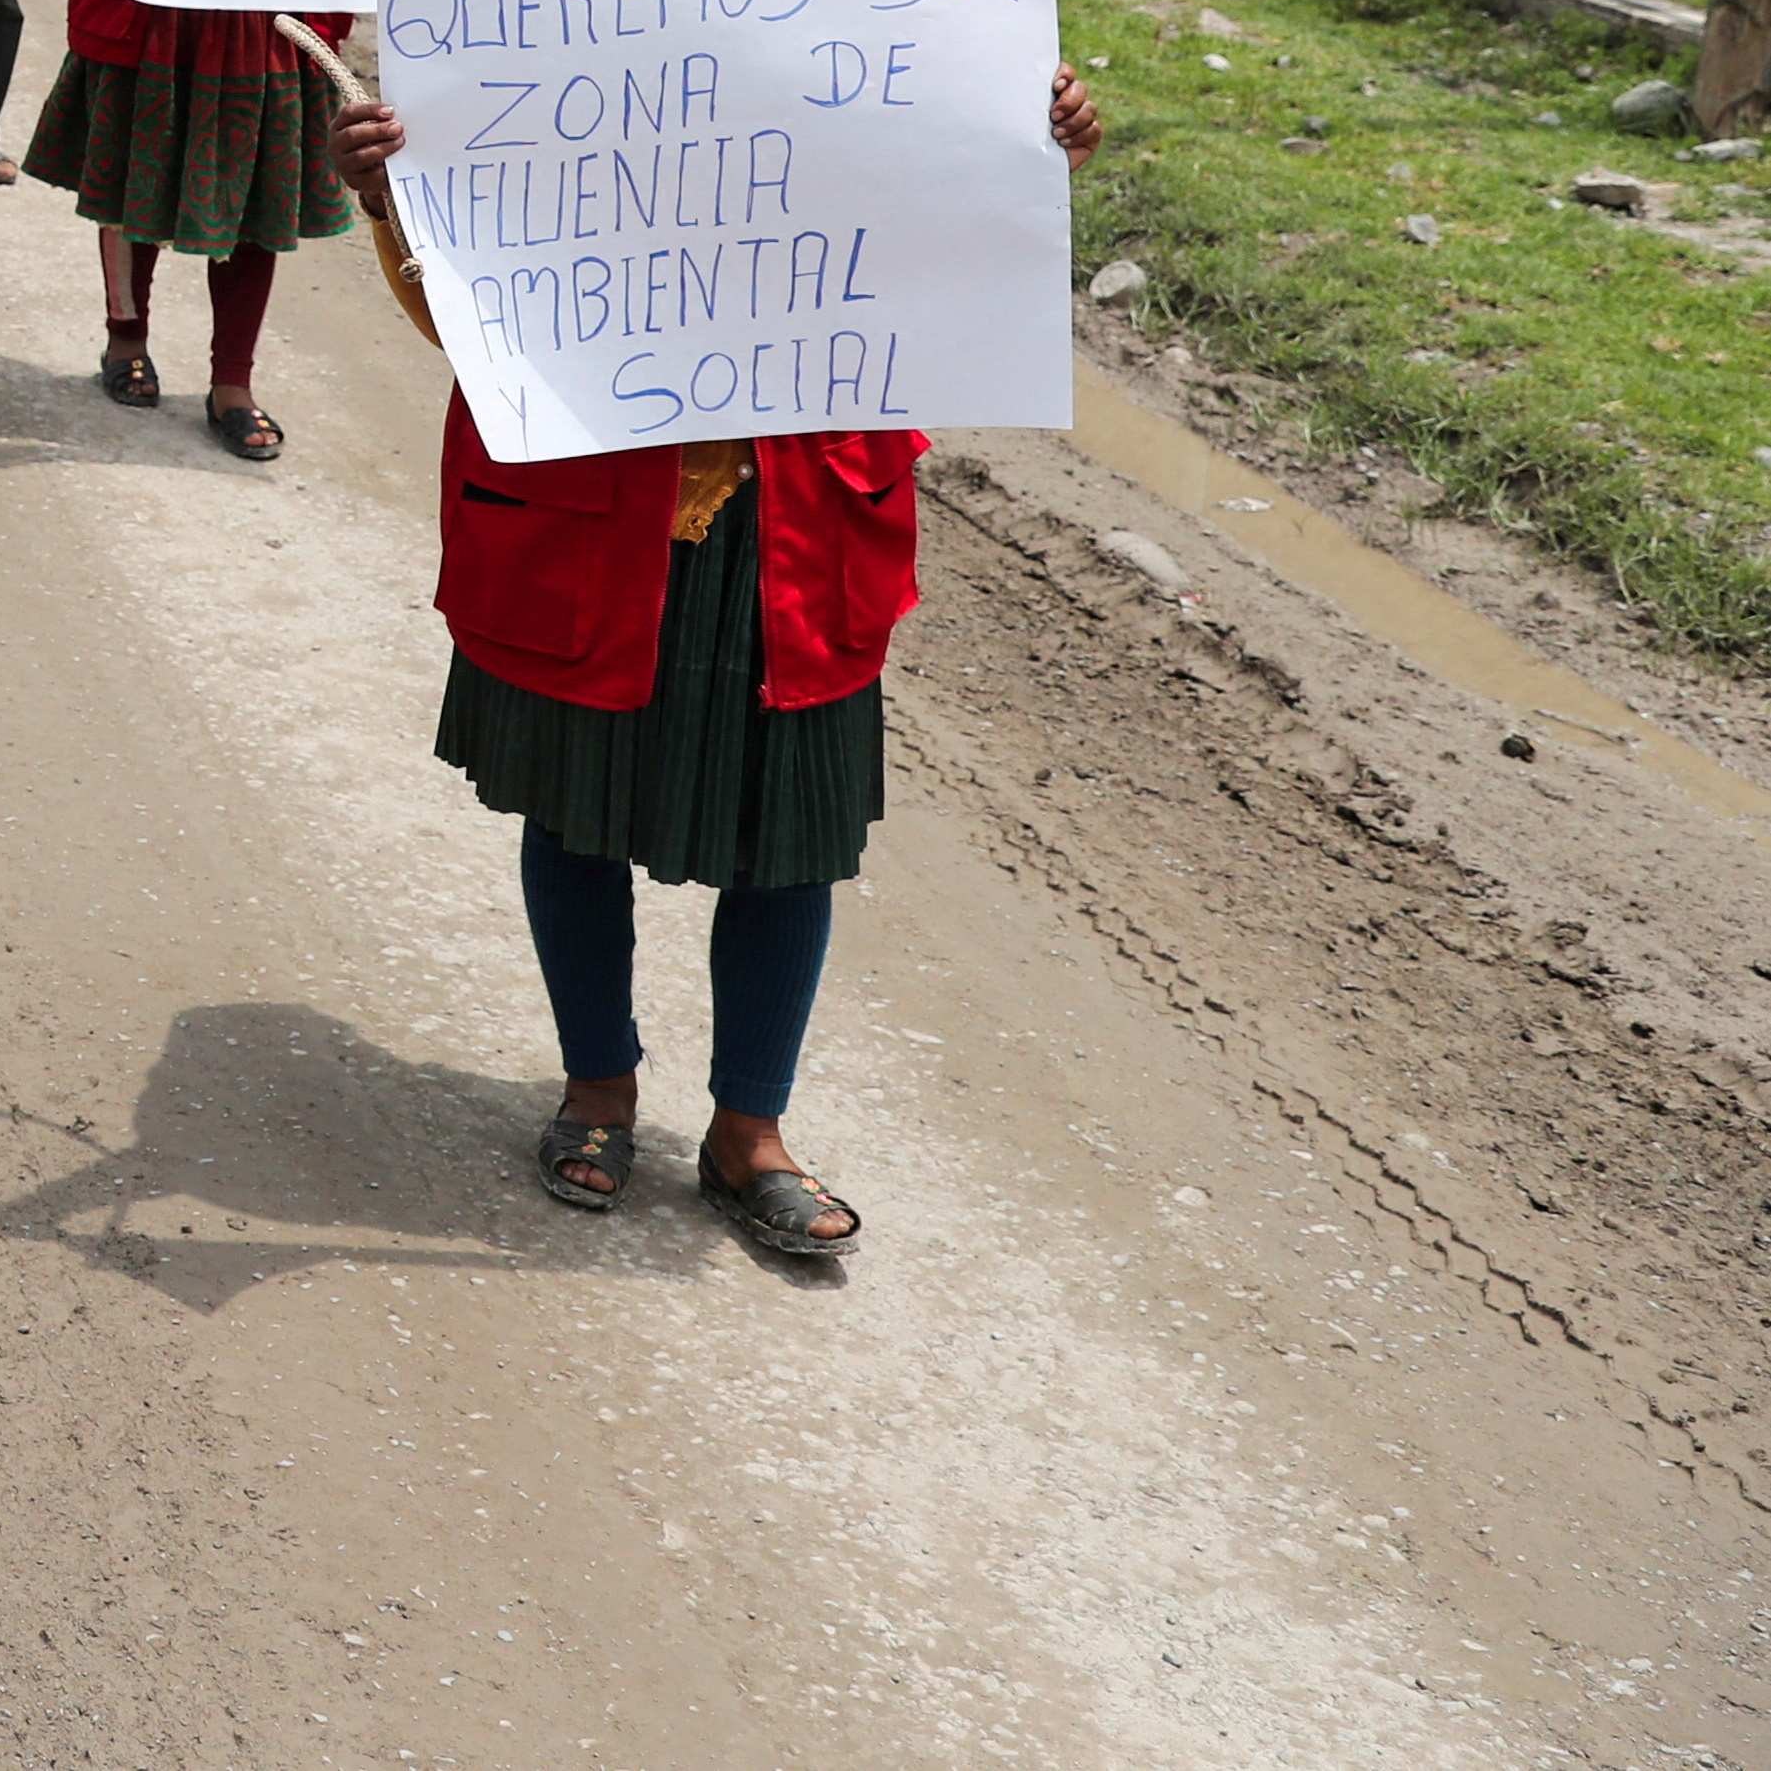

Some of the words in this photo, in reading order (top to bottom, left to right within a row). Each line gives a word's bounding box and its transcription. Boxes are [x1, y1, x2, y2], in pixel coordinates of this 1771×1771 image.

[463, 52, 719, 151] ZONA
[802, 40, 918, 108] DE
[396, 129, 793, 252] INFLUENCIA
[470, 227, 877, 363] AMBIENTAL
[496, 381, 531, 461] Y
[611, 331, 910, 436] SOCIAL
